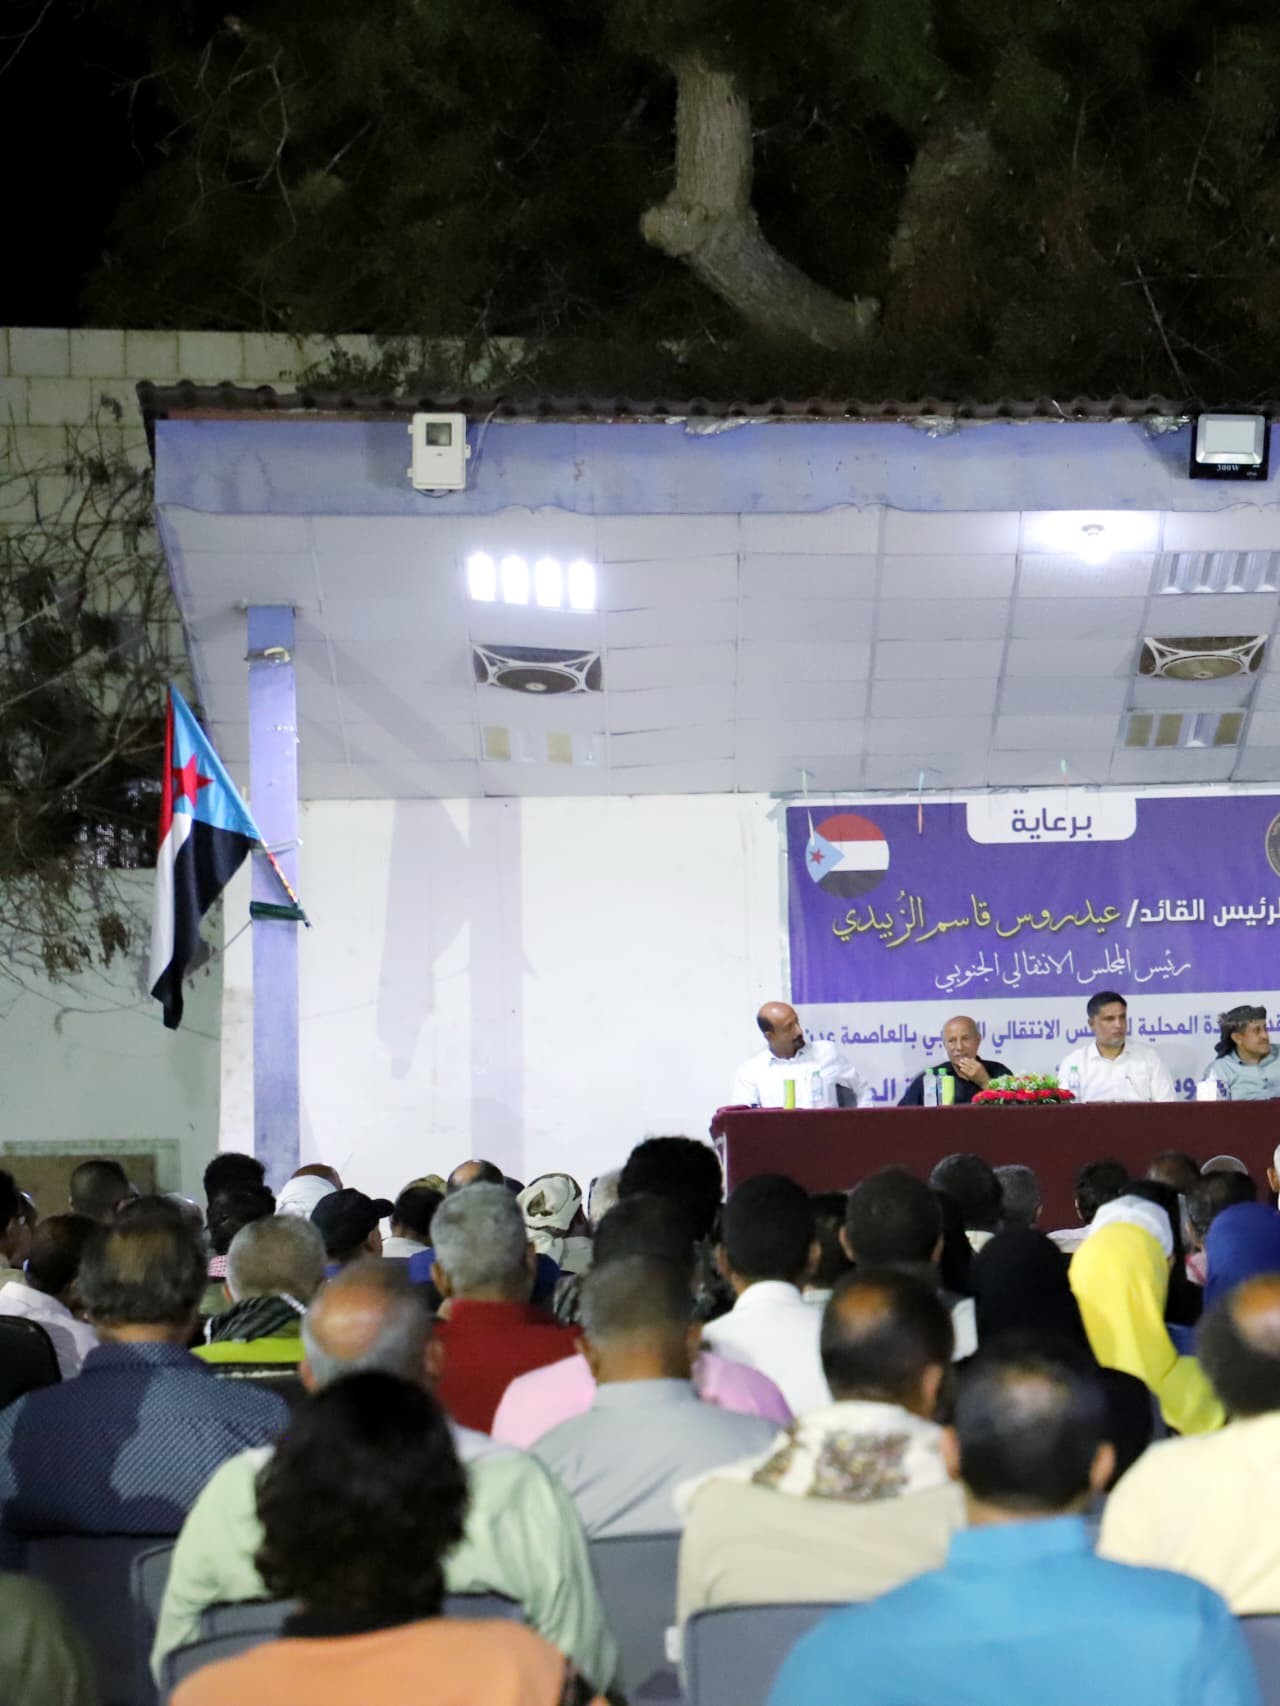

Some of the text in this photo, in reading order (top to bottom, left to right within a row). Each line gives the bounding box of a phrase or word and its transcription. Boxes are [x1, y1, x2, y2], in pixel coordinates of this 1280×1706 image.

[1011, 807, 1093, 840] برعاية
[915, 893, 991, 943] قاسم
[995, 899, 1120, 937] عيدروس
[1126, 898, 1205, 929] القائد/
[935, 943, 1191, 992] رئيس المجلس الانتقالي الجنوبي
[841, 1023, 918, 1049] بالعاصمة
[991, 1019, 1060, 1053] الانتقالي
[1138, 1015, 1198, 1042] المحلية
